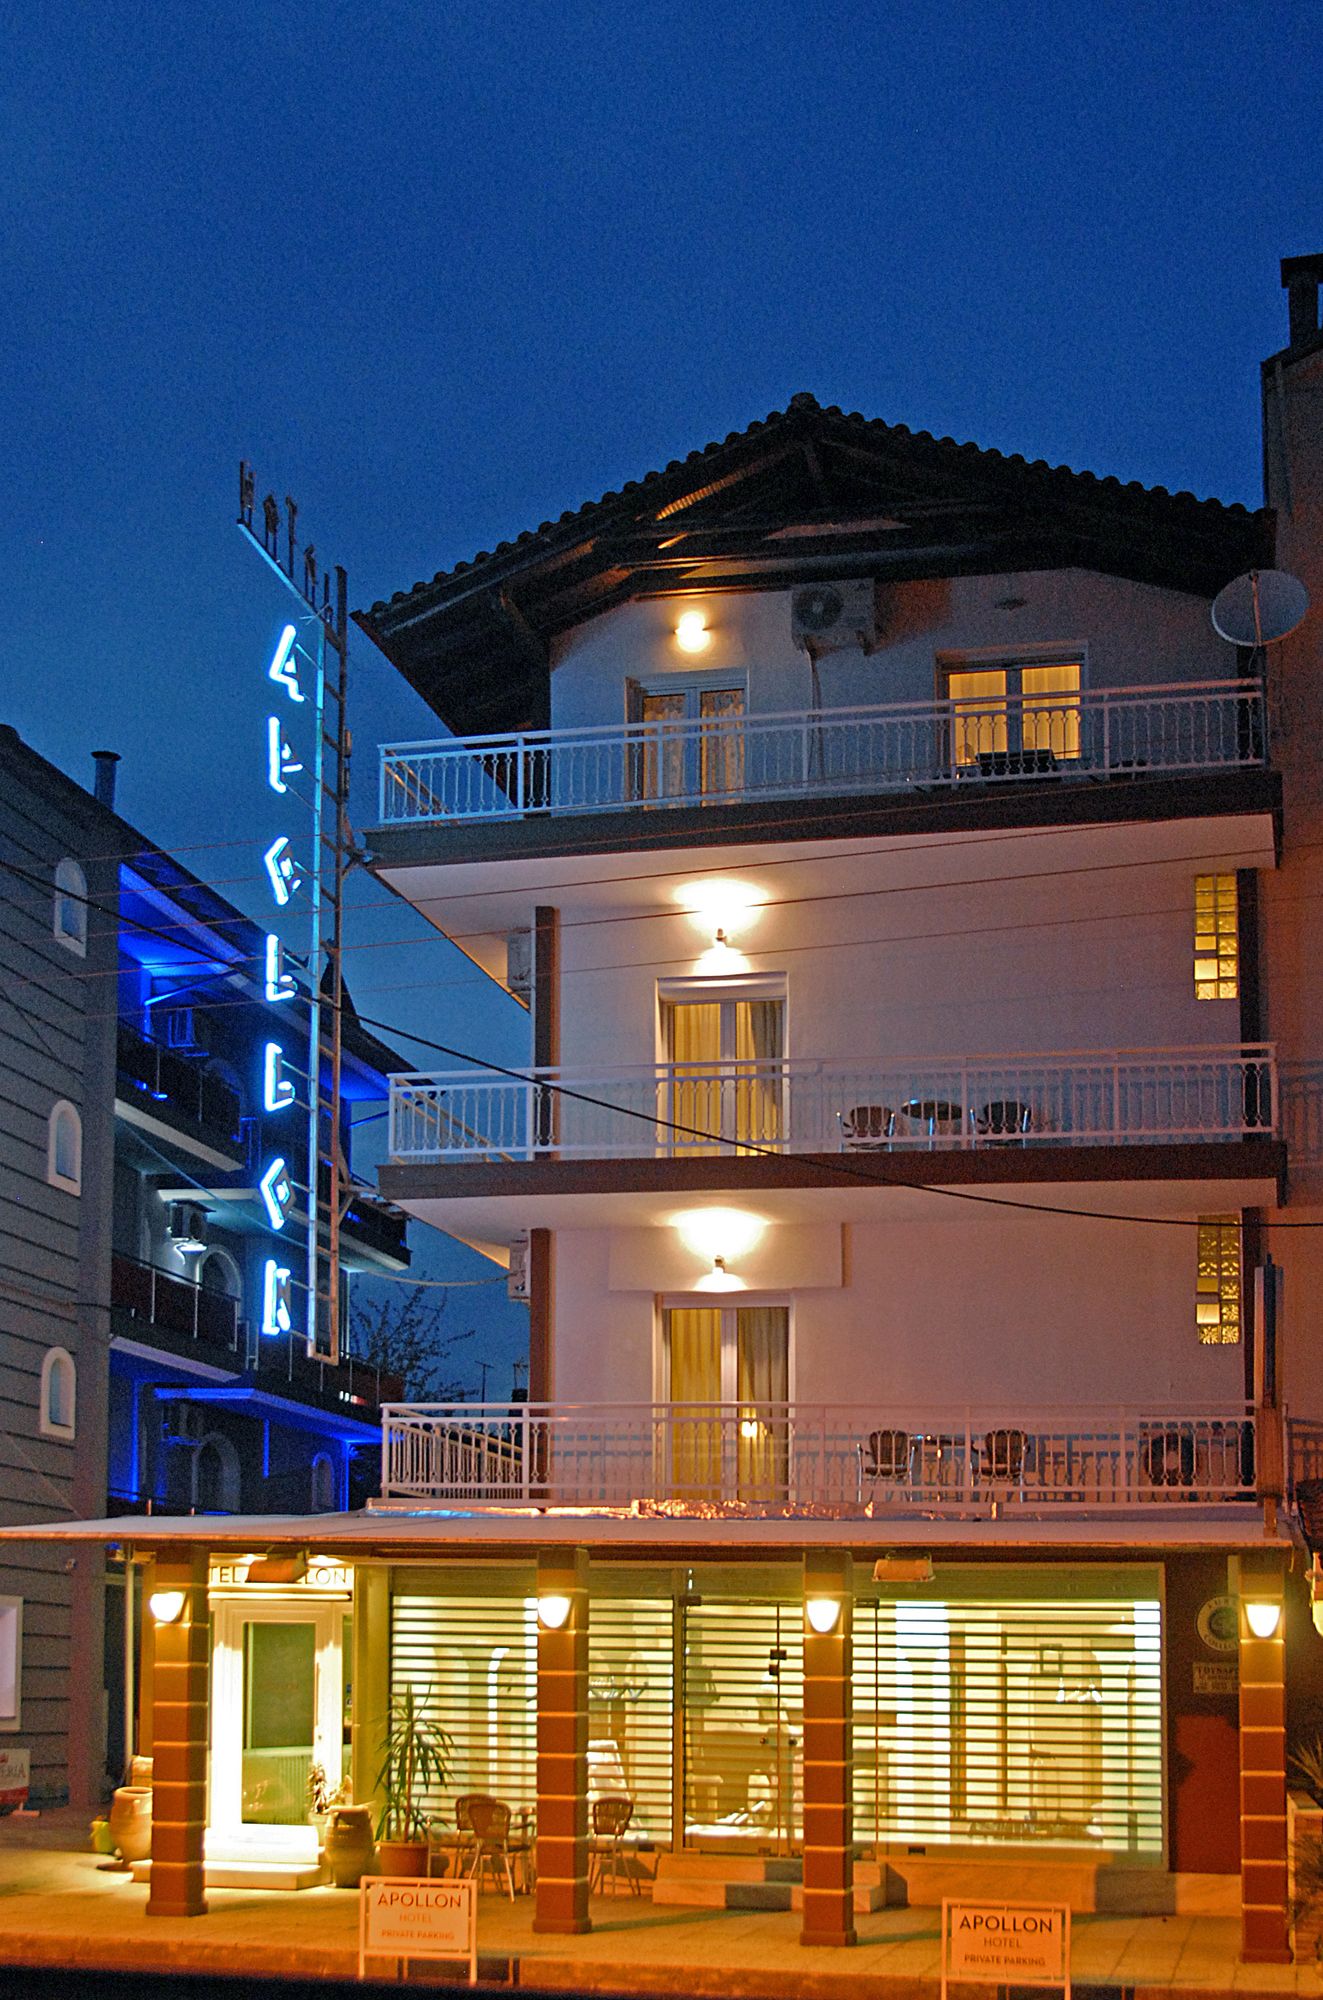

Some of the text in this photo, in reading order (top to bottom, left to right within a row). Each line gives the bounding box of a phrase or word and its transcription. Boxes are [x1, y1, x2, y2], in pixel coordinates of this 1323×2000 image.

[209, 1565, 242, 1583] TEL
[377, 1892, 462, 1908] APOLLON
[399, 1912, 433, 1924] HOTEL
[959, 1915, 1053, 1933] APOLLON
[381, 1928, 455, 1941] PRIVATE PARKING
[983, 1936, 1022, 1949] HOTEL
[964, 1953, 1046, 1967] PRIVATE PARKING
